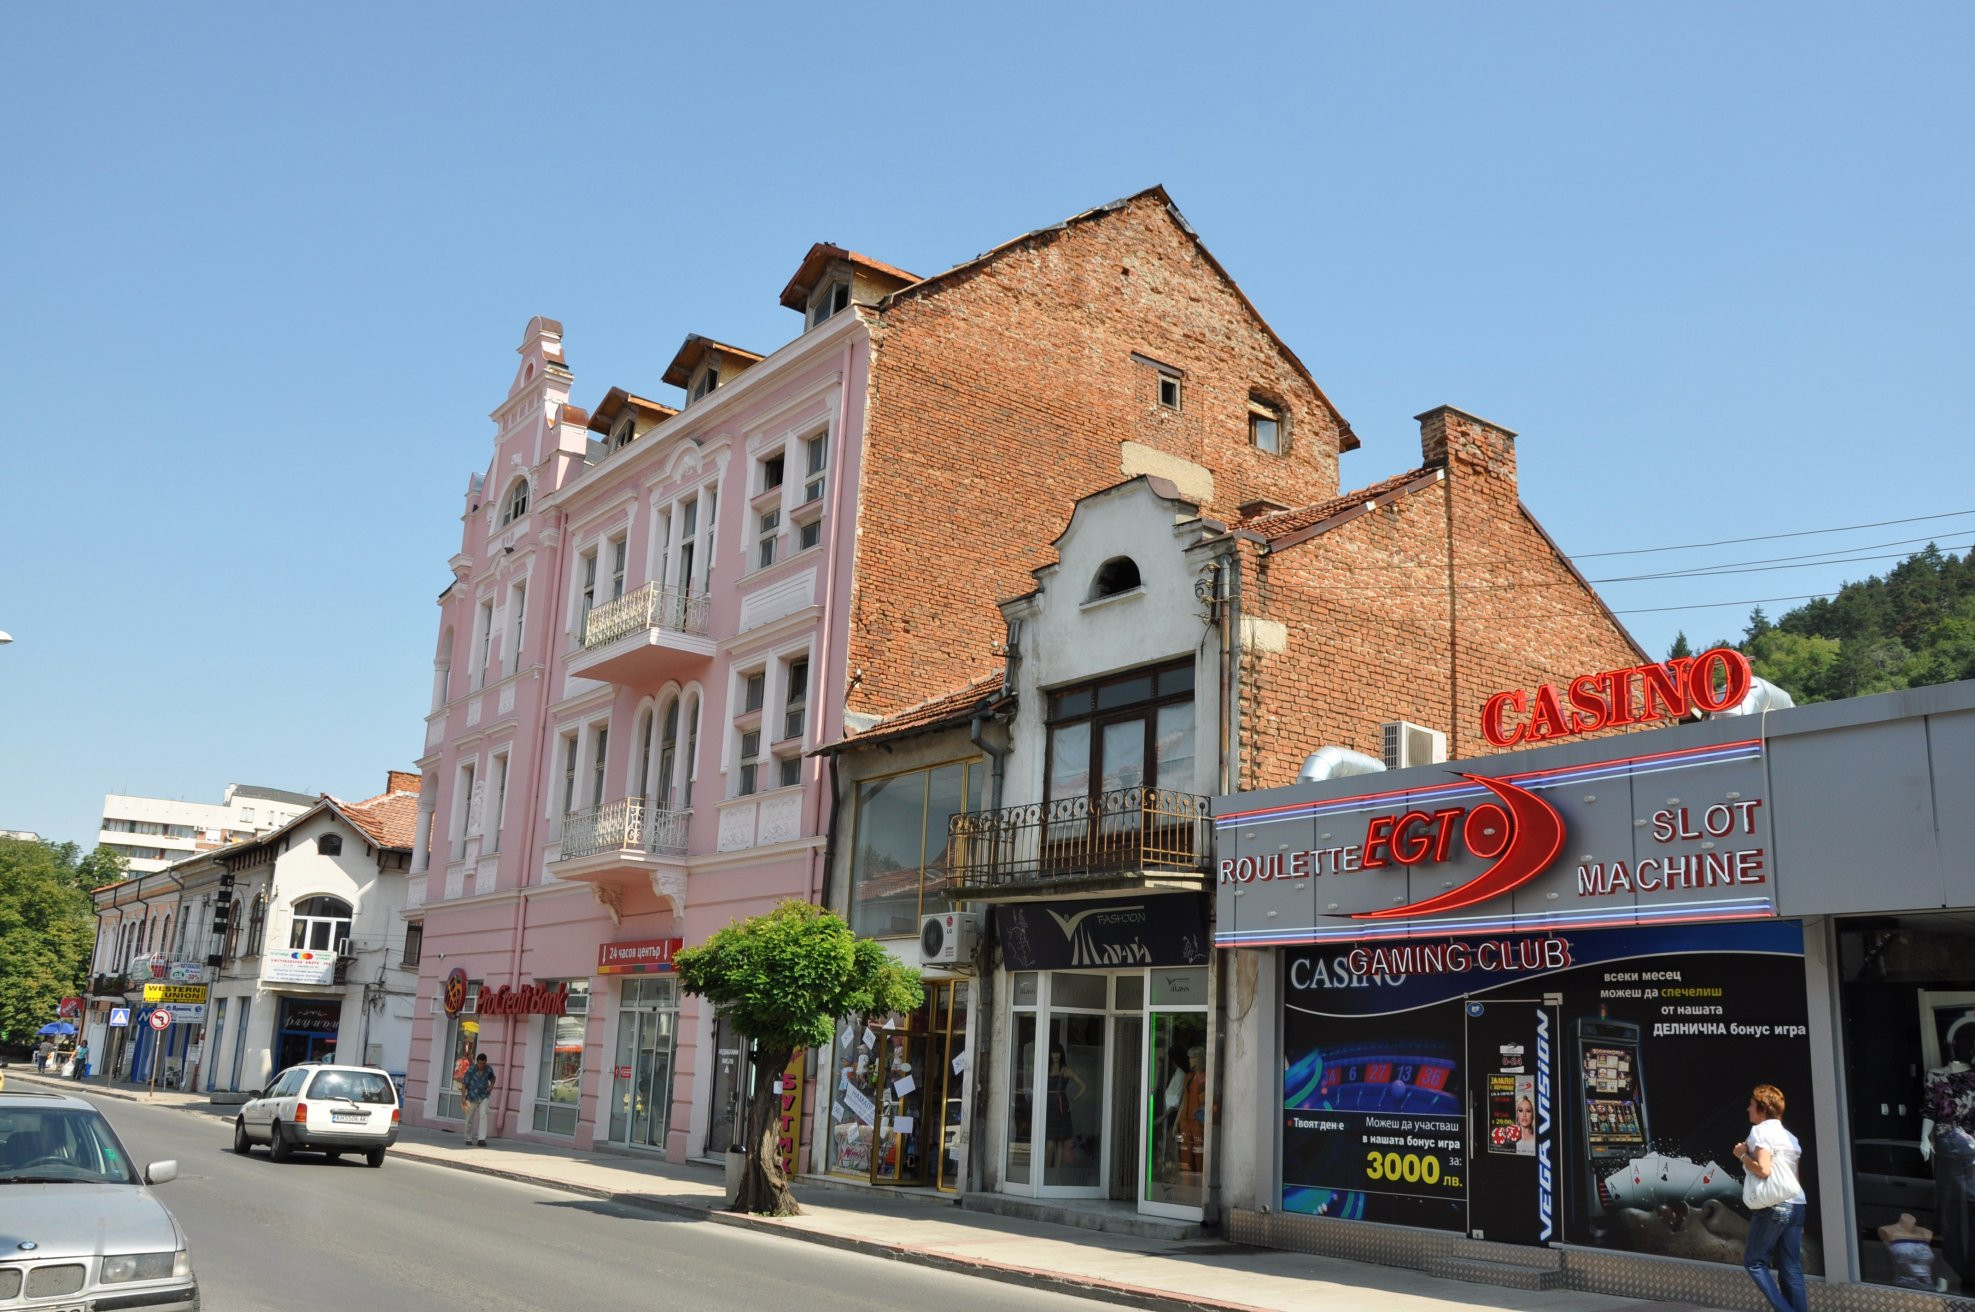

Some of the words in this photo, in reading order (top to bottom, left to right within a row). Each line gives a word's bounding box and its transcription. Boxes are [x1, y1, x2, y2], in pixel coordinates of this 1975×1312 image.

[1482, 647, 1750, 747] CASINO
[1653, 799, 1762, 843] SLOT
[1363, 807, 1465, 870] EGT
[1220, 844, 1362, 884] ROULETTE
[1577, 849, 1765, 897] MACHINE
[609, 946, 617, 960] 24
[619, 947, 635, 959] часов
[637, 945, 660, 960] център
[1349, 941, 1471, 976] GAMING
[1477, 937, 1571, 971] CLUB
[1604, 972, 1639, 982] всеки
[1642, 970, 1682, 982] месец
[476, 984, 534, 1014] ProCredit
[530, 980, 568, 1014] Bank
[1600, 988, 1641, 998] можеш
[1644, 989, 1659, 999] да
[1661, 987, 1722, 997] спечелиш
[1661, 1005, 1674, 1015] от
[1677, 1005, 1723, 1015] нашата
[1653, 1022, 1726, 1037] ДЕЛНИЧНА
[1730, 1022, 1770, 1038] бонус
[1774, 1024, 1806, 1038] игра
[1349, 1066, 1357, 1081] 6
[1369, 1064, 1387, 1080] 27
[1397, 1065, 1412, 1082] 13
[1421, 1069, 1441, 1085] 36
[1294, 1117, 1318, 1129] Твоят
[1319, 1120, 1337, 1131] ден
[1339, 1122, 1344, 1130] е
[1366, 1117, 1399, 1129] Можеш
[1401, 1119, 1412, 1131] да
[1414, 1121, 1459, 1132] участваш
[1362, 1134, 1368, 1143] в
[1370, 1134, 1404, 1146] нашата
[1407, 1136, 1435, 1150] бонус
[1438, 1138, 1460, 1151] игра
[1366, 1151, 1440, 1185] 3000
[1449, 1156, 1462, 1166] за:
[1443, 1175, 1463, 1187] лв.
[1539, 1139, 1553, 1240] VEGA
